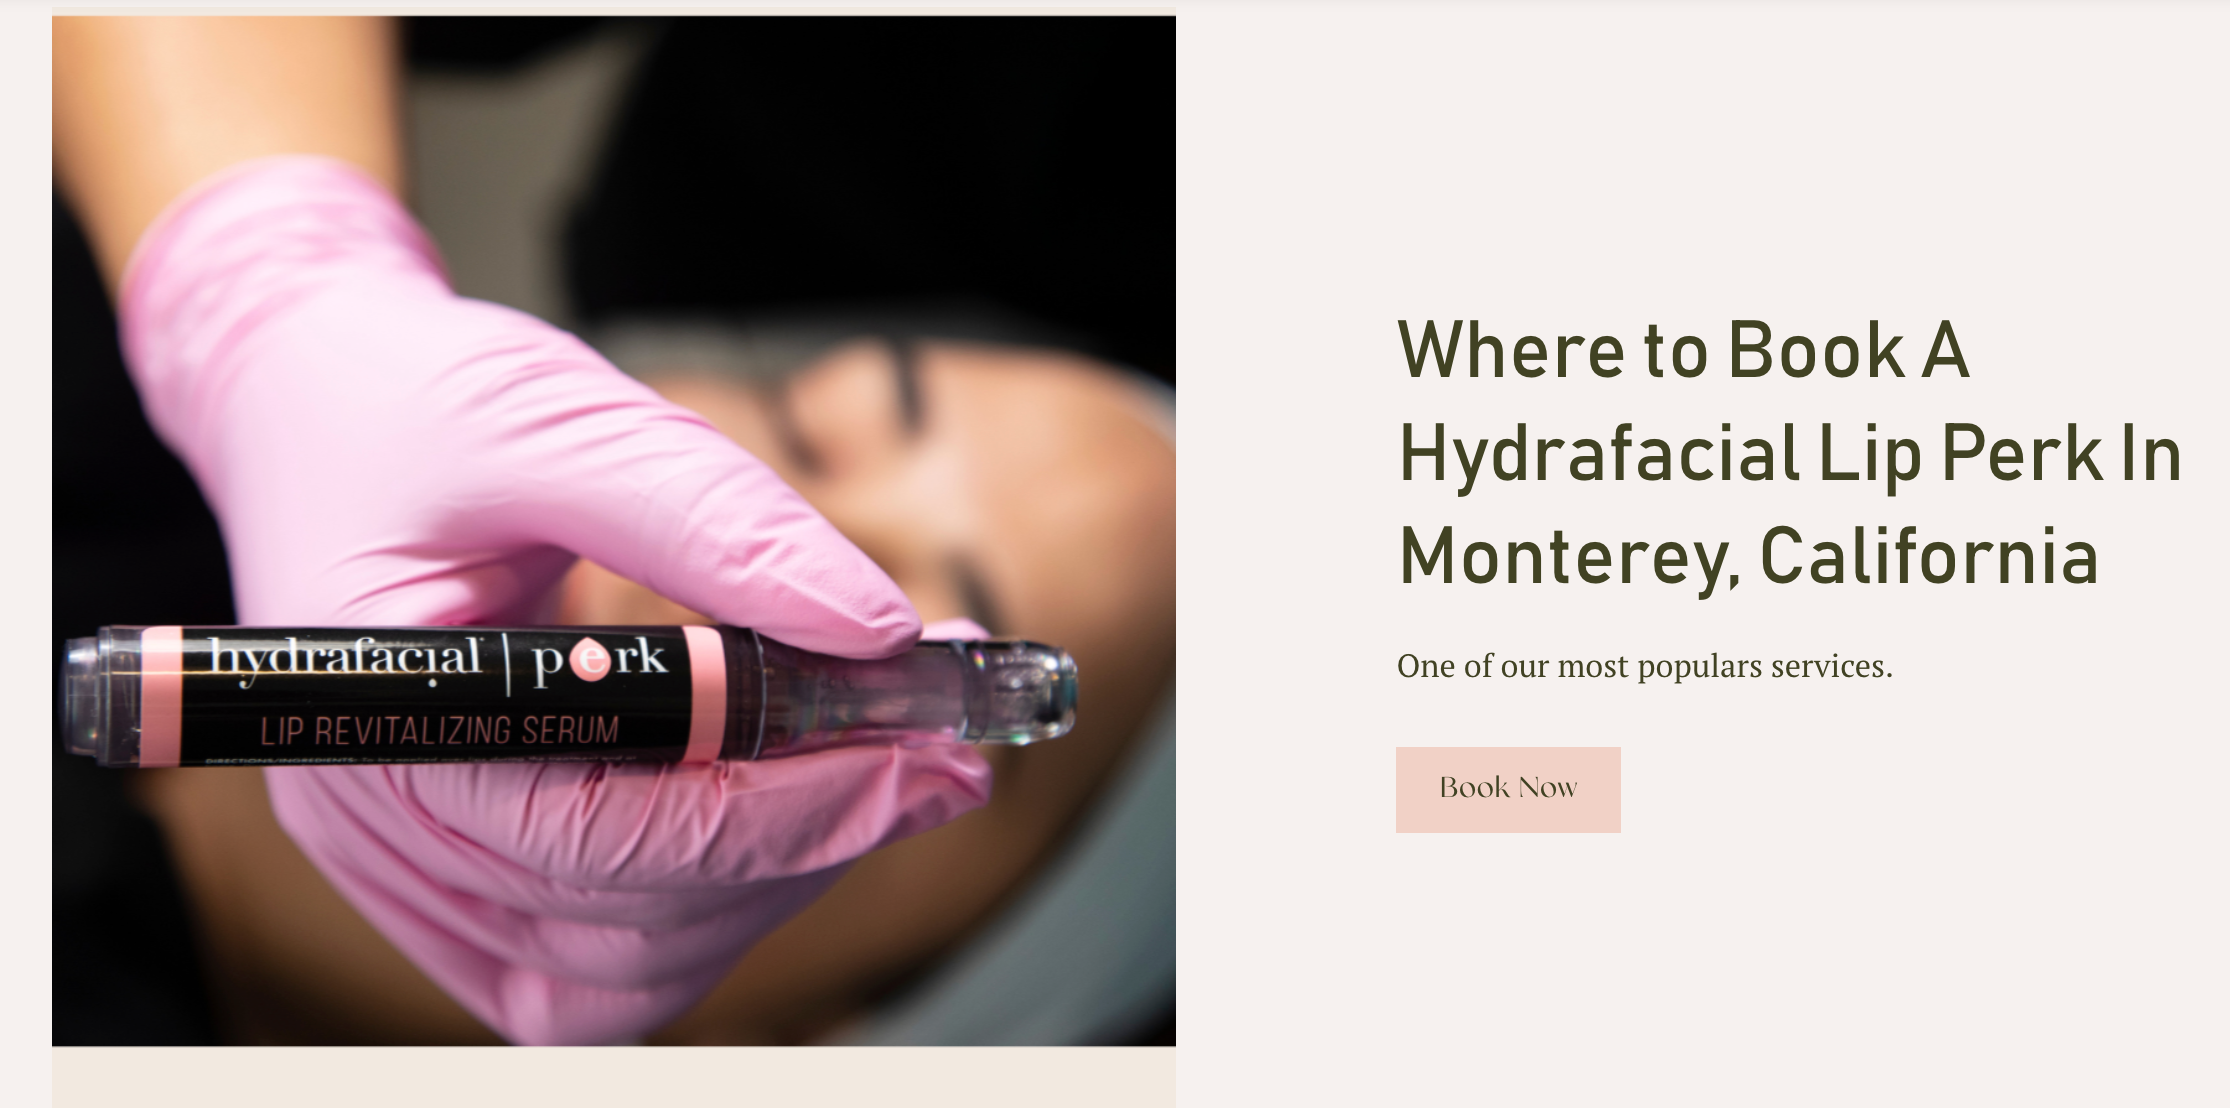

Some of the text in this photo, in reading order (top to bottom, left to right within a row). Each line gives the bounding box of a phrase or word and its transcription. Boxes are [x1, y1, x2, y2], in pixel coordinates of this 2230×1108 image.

[206, 636, 670, 690] hydrafacial perk
[260, 715, 620, 746] LIP REVITALIZING SERUM
